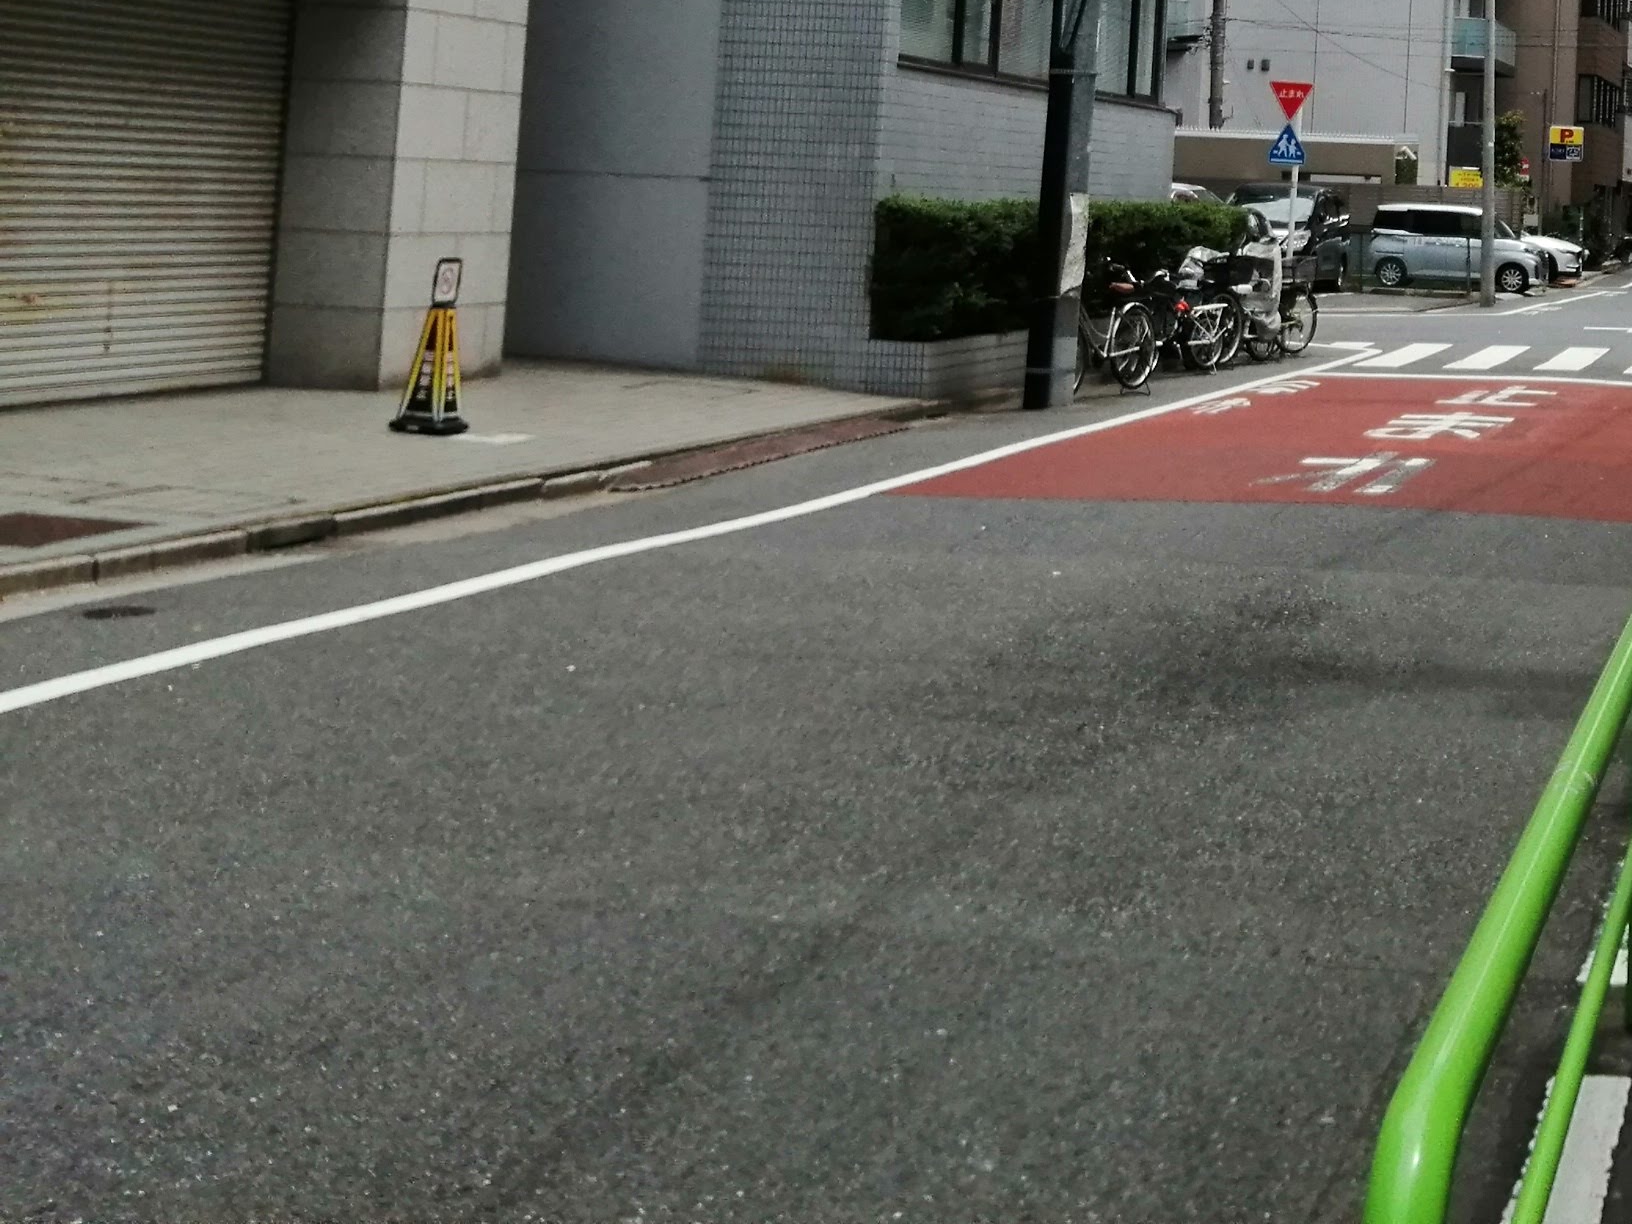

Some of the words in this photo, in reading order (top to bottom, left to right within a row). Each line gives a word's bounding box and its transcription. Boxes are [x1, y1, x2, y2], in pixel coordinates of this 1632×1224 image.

[1279, 88, 1304, 99] 止まれ
[1560, 129, 1574, 143] P
